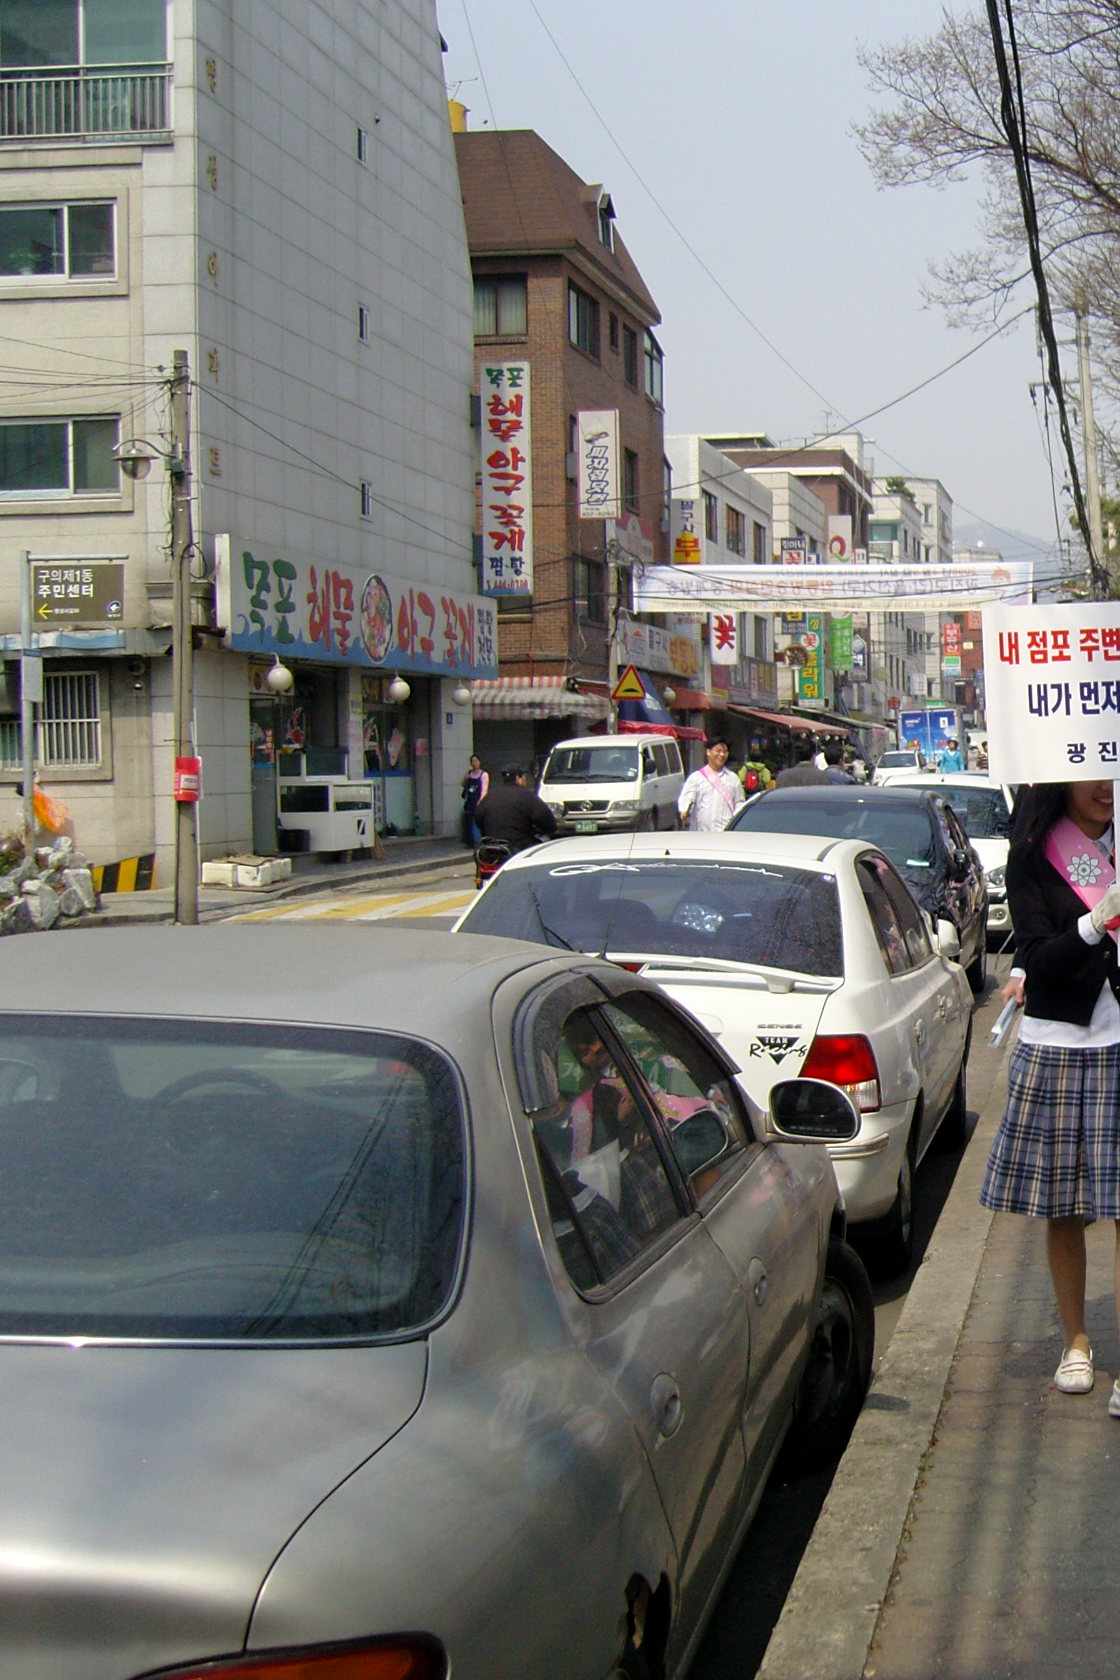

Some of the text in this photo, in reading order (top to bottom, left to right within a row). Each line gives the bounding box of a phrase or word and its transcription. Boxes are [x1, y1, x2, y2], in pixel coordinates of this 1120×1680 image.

[485, 366, 525, 389] 목포
[486, 393, 525, 443] 해물
[486, 446, 527, 497] 아구
[488, 503, 526, 552] 꽃게
[37, 584, 94, 598] 주민센터
[38, 568, 94, 583] 구의제1동
[241, 551, 476, 669] 목포 해물 아구 꽃게
[713, 613, 737, 650] 꽃
[998, 631, 1020, 665] 내
[1027, 629, 1071, 664] 점포
[1028, 680, 1072, 717] 내가
[765, 1036, 789, 1044] TEAM
